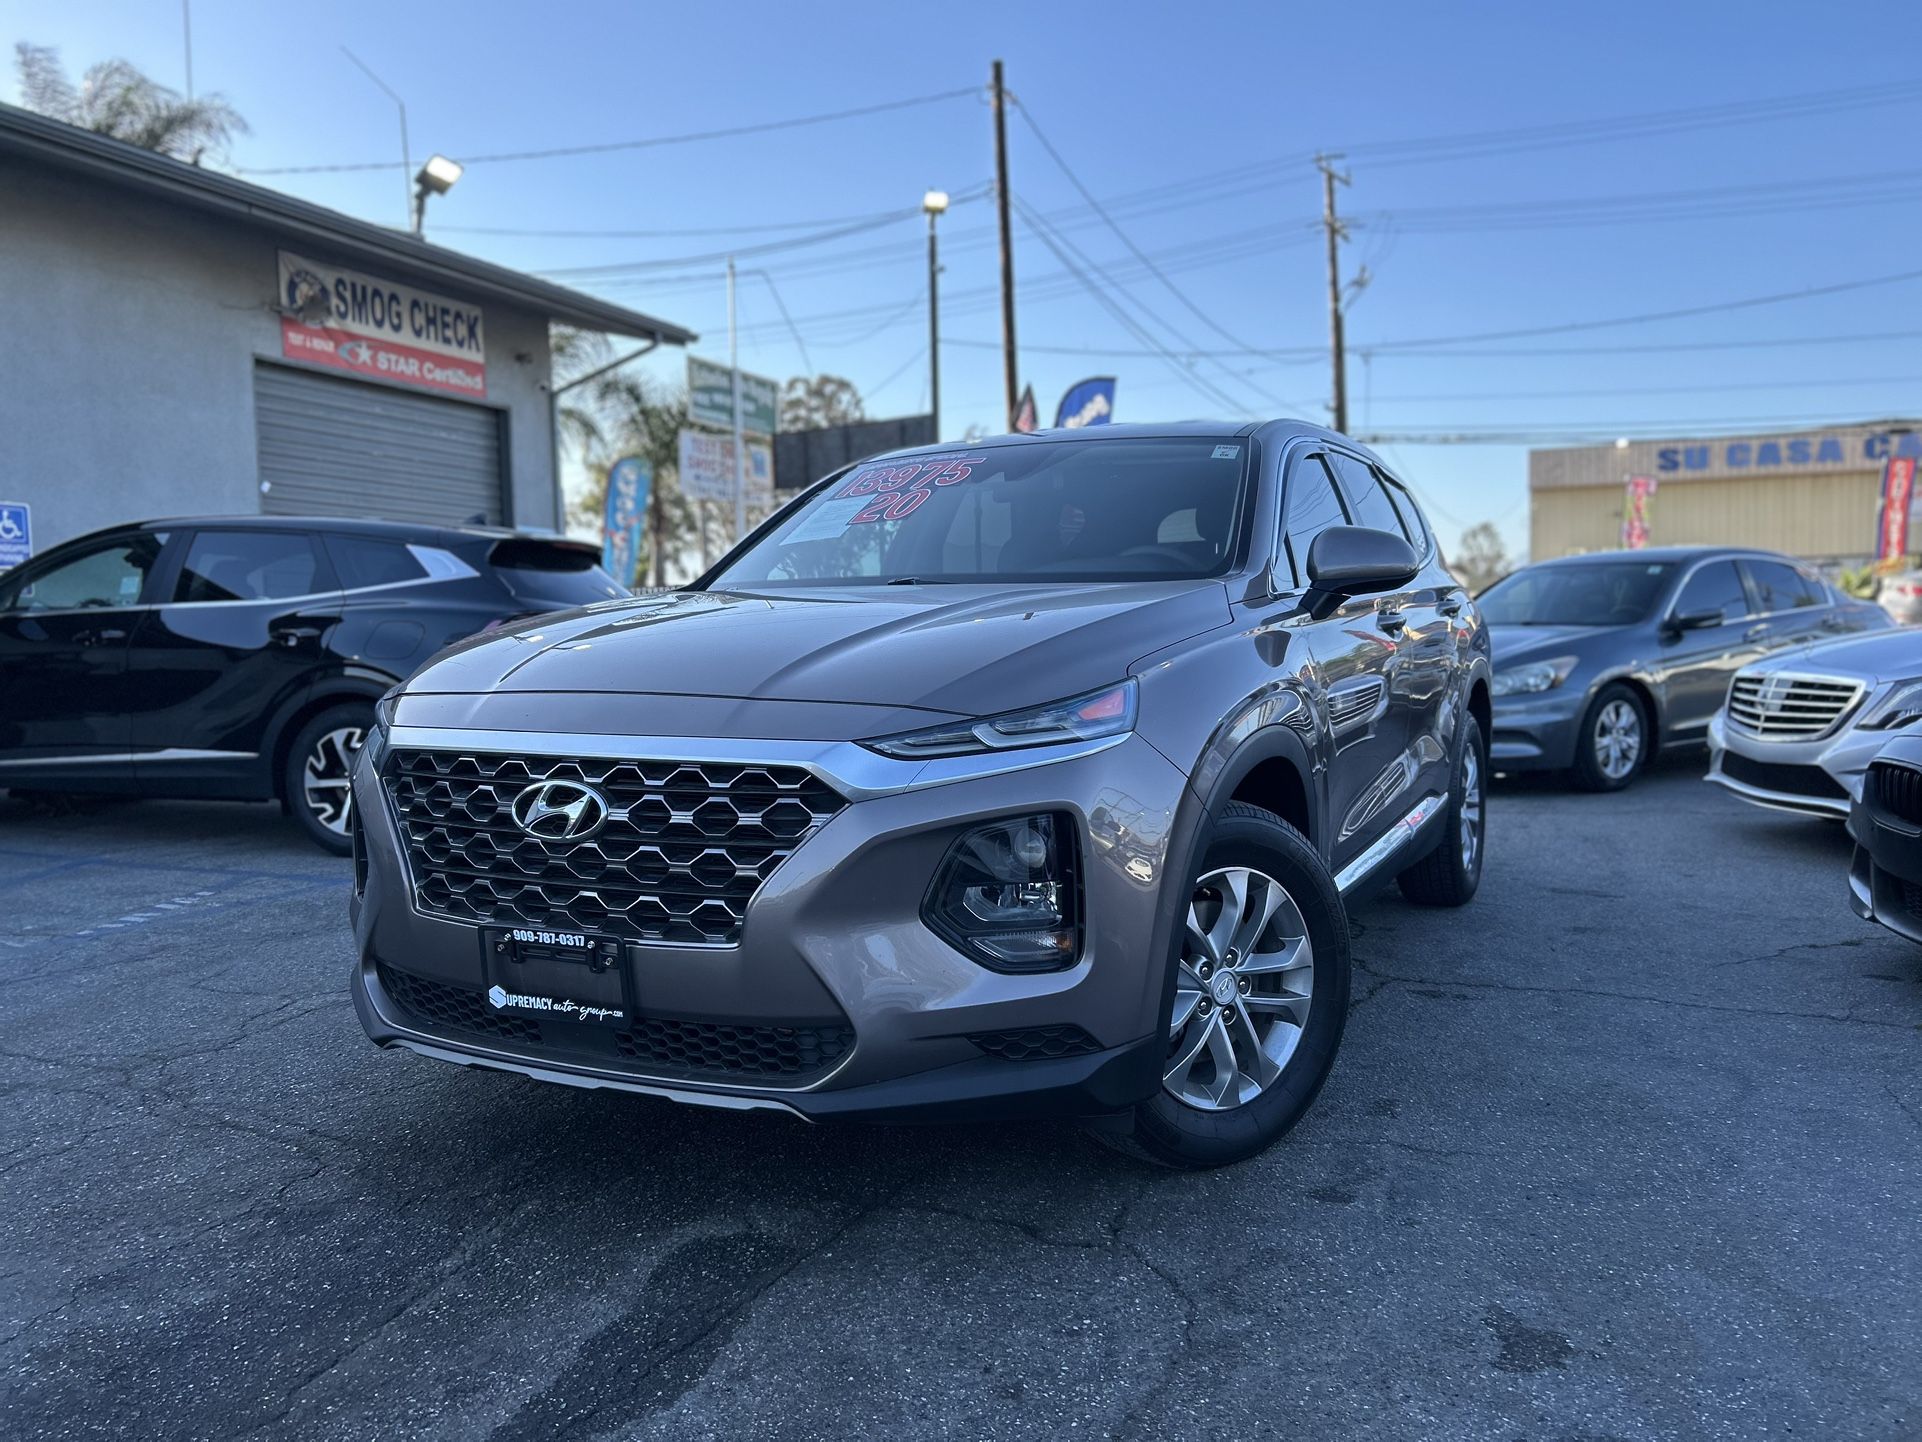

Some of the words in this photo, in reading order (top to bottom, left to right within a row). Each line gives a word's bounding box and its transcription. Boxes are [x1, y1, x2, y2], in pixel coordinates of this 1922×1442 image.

[335, 277, 402, 333] SMOG
[410, 299, 480, 352] CHECK
[377, 351, 419, 378] STAR
[1658, 446, 1709, 471] SU
[1726, 436, 1844, 467] CASA
[847, 488, 931, 525] 20
[513, 929, 585, 947] 909-787-0317
[488, 984, 552, 1011] SUPREMACY
[553, 1000, 578, 1012] auto
